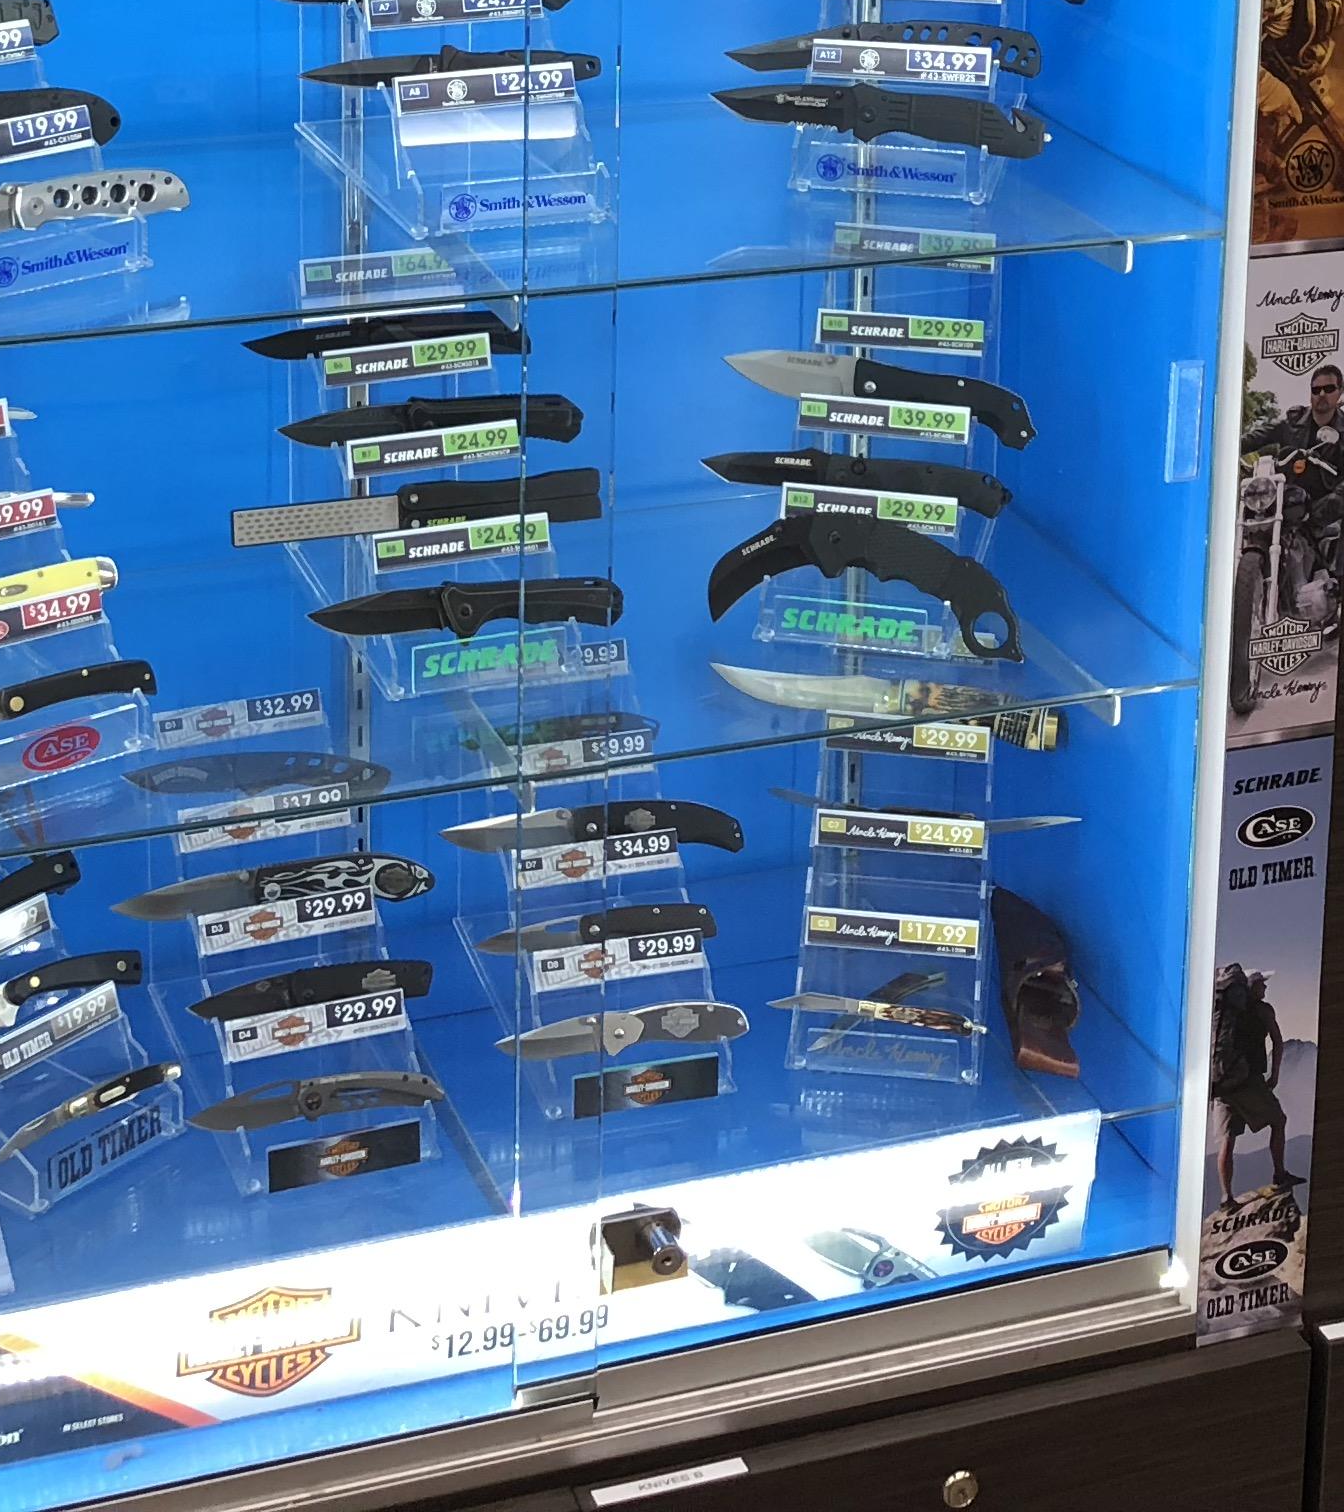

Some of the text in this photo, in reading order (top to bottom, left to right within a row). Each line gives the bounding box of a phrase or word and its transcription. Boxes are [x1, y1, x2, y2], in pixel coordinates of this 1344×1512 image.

[915, 51, 976, 71] $34.99
[17, 109, 79, 137] $19.99
[335, 267, 388, 282] SCHRADE
[1257, 290, 1302, 307] Uncle
[850, 319, 975, 339] SCHRADE $29.99
[1283, 322, 1320, 334] MOTOR
[355, 340, 477, 375] SCHRADE $29.99
[1282, 352, 1318, 370] CYCLES
[829, 408, 956, 429] SCHRADE $39.99
[384, 428, 508, 464] SCHRADE $24.99
[886, 499, 946, 521] $29.99
[408, 523, 537, 559] SCHRADE $24.99
[29, 593, 91, 621] $34.99
[782, 607, 916, 642] SCHRADE
[422, 639, 556, 678] SCHRADE
[255, 693, 314, 717] $32.99
[922, 729, 977, 748] $29.99
[1233, 768, 1320, 795] SCHRADE
[614, 834, 671, 856] $34.99
[916, 823, 973, 843] $24.99
[1229, 856, 1314, 890] OLD TIMER
[305, 892, 366, 917] $29.99
[637, 934, 696, 956] $29.99
[908, 923, 966, 942] $17.99
[57, 995, 108, 1029] $19.99
[334, 996, 396, 1021] $29.99
[56, 1105, 162, 1190] OLD TIMER
[1211, 1206, 1295, 1234] SCHRADE
[1207, 1283, 1289, 1319] OLD TIMER
[226, 1353, 316, 1388] CYCLES
[638, 1475, 689, 1491] KNIVES
